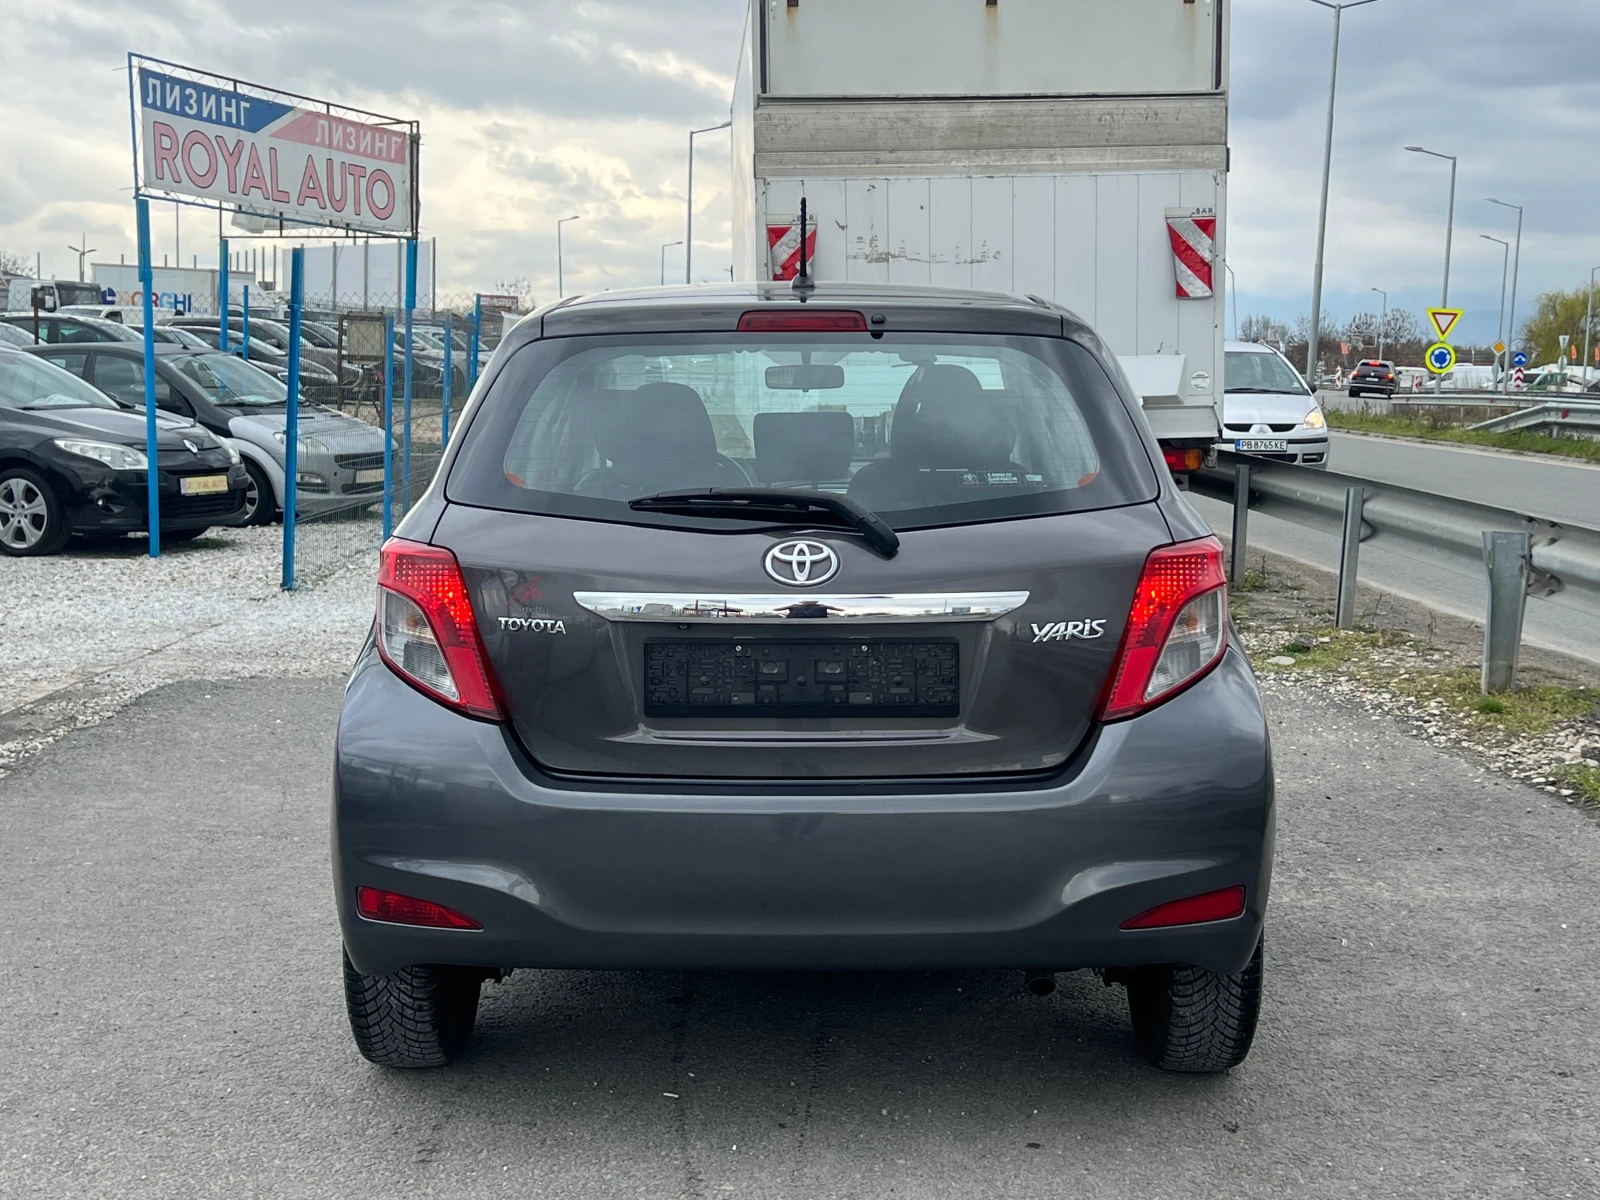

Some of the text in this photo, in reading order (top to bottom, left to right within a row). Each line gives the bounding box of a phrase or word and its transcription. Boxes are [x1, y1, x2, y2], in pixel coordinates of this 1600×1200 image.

[147, 78, 250, 126] ЛИЗИНГ
[315, 120, 402, 159] ЛИЗИНГ
[153, 121, 395, 220] ROYAL AUTO
[1241, 440, 1285, 449] PB 8765 KE
[497, 616, 566, 635] TOYOTA
